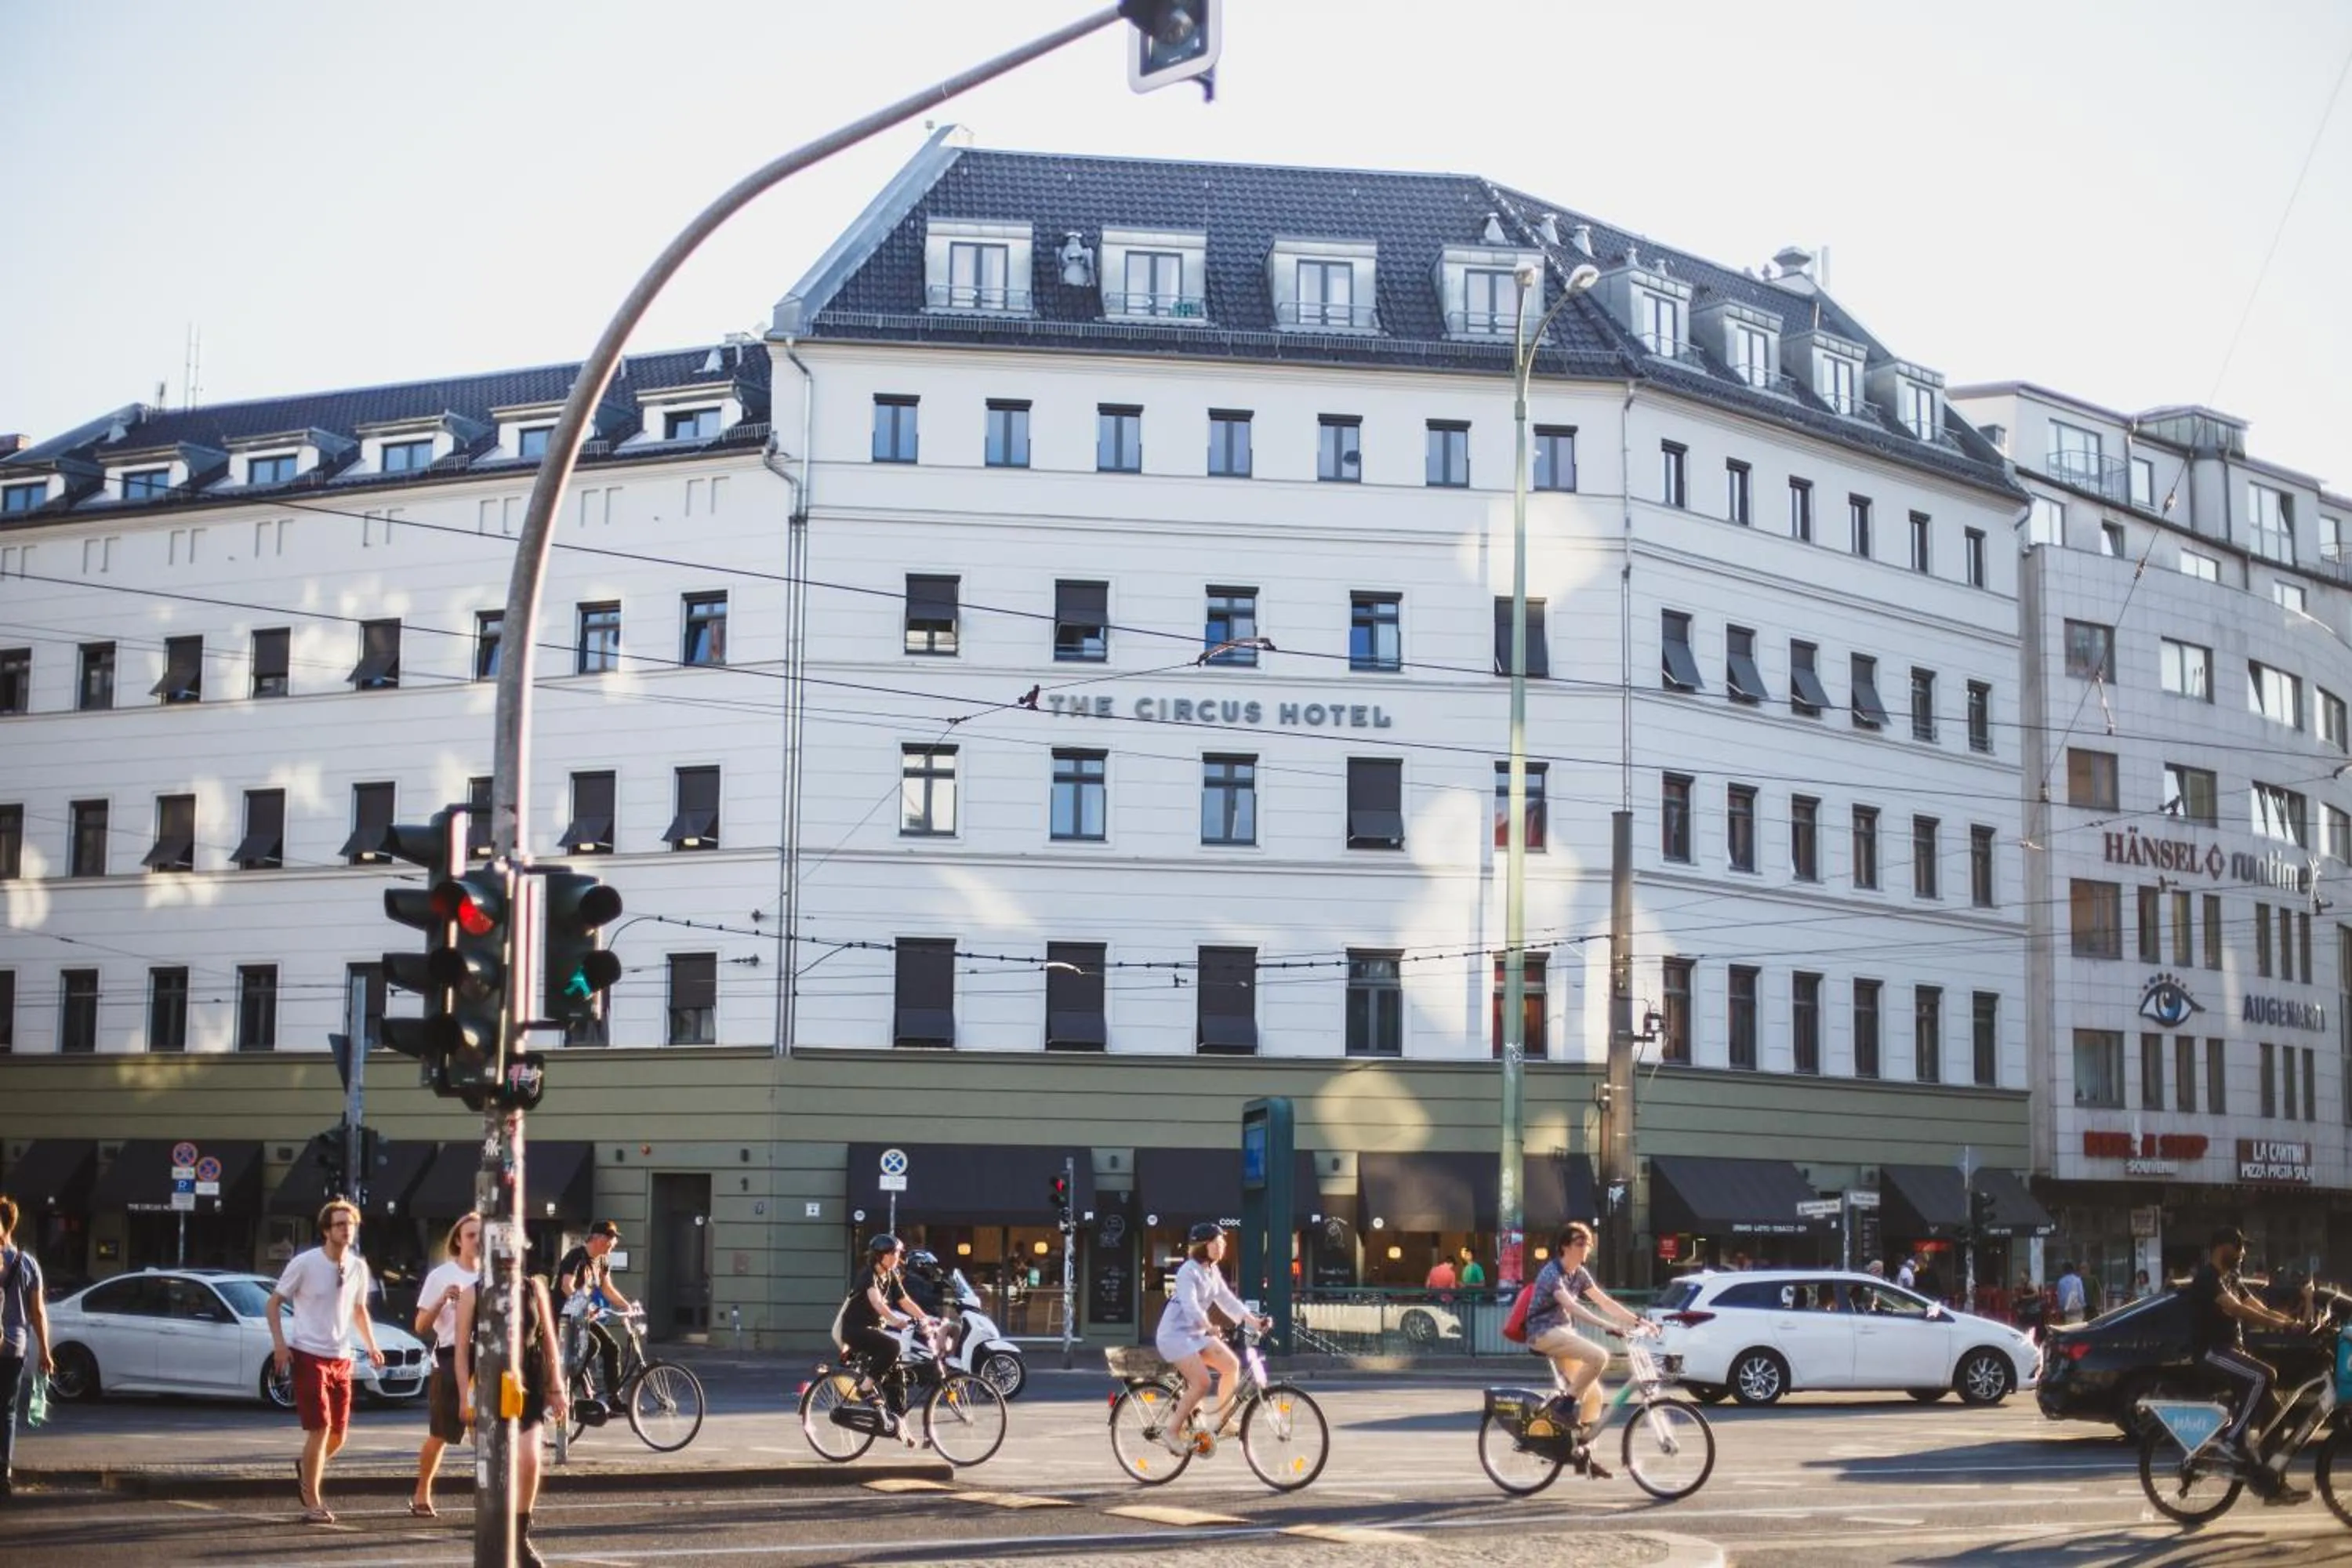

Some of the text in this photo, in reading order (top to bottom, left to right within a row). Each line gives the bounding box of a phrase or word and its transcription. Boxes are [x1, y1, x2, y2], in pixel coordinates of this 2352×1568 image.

[1047, 694, 1392, 728] THE CIRCUS HOTEL
[2104, 826, 2203, 874] HÄNSEL
[2253, 1142, 2267, 1162] LA
[2241, 1162, 2267, 1178] PIZZA
